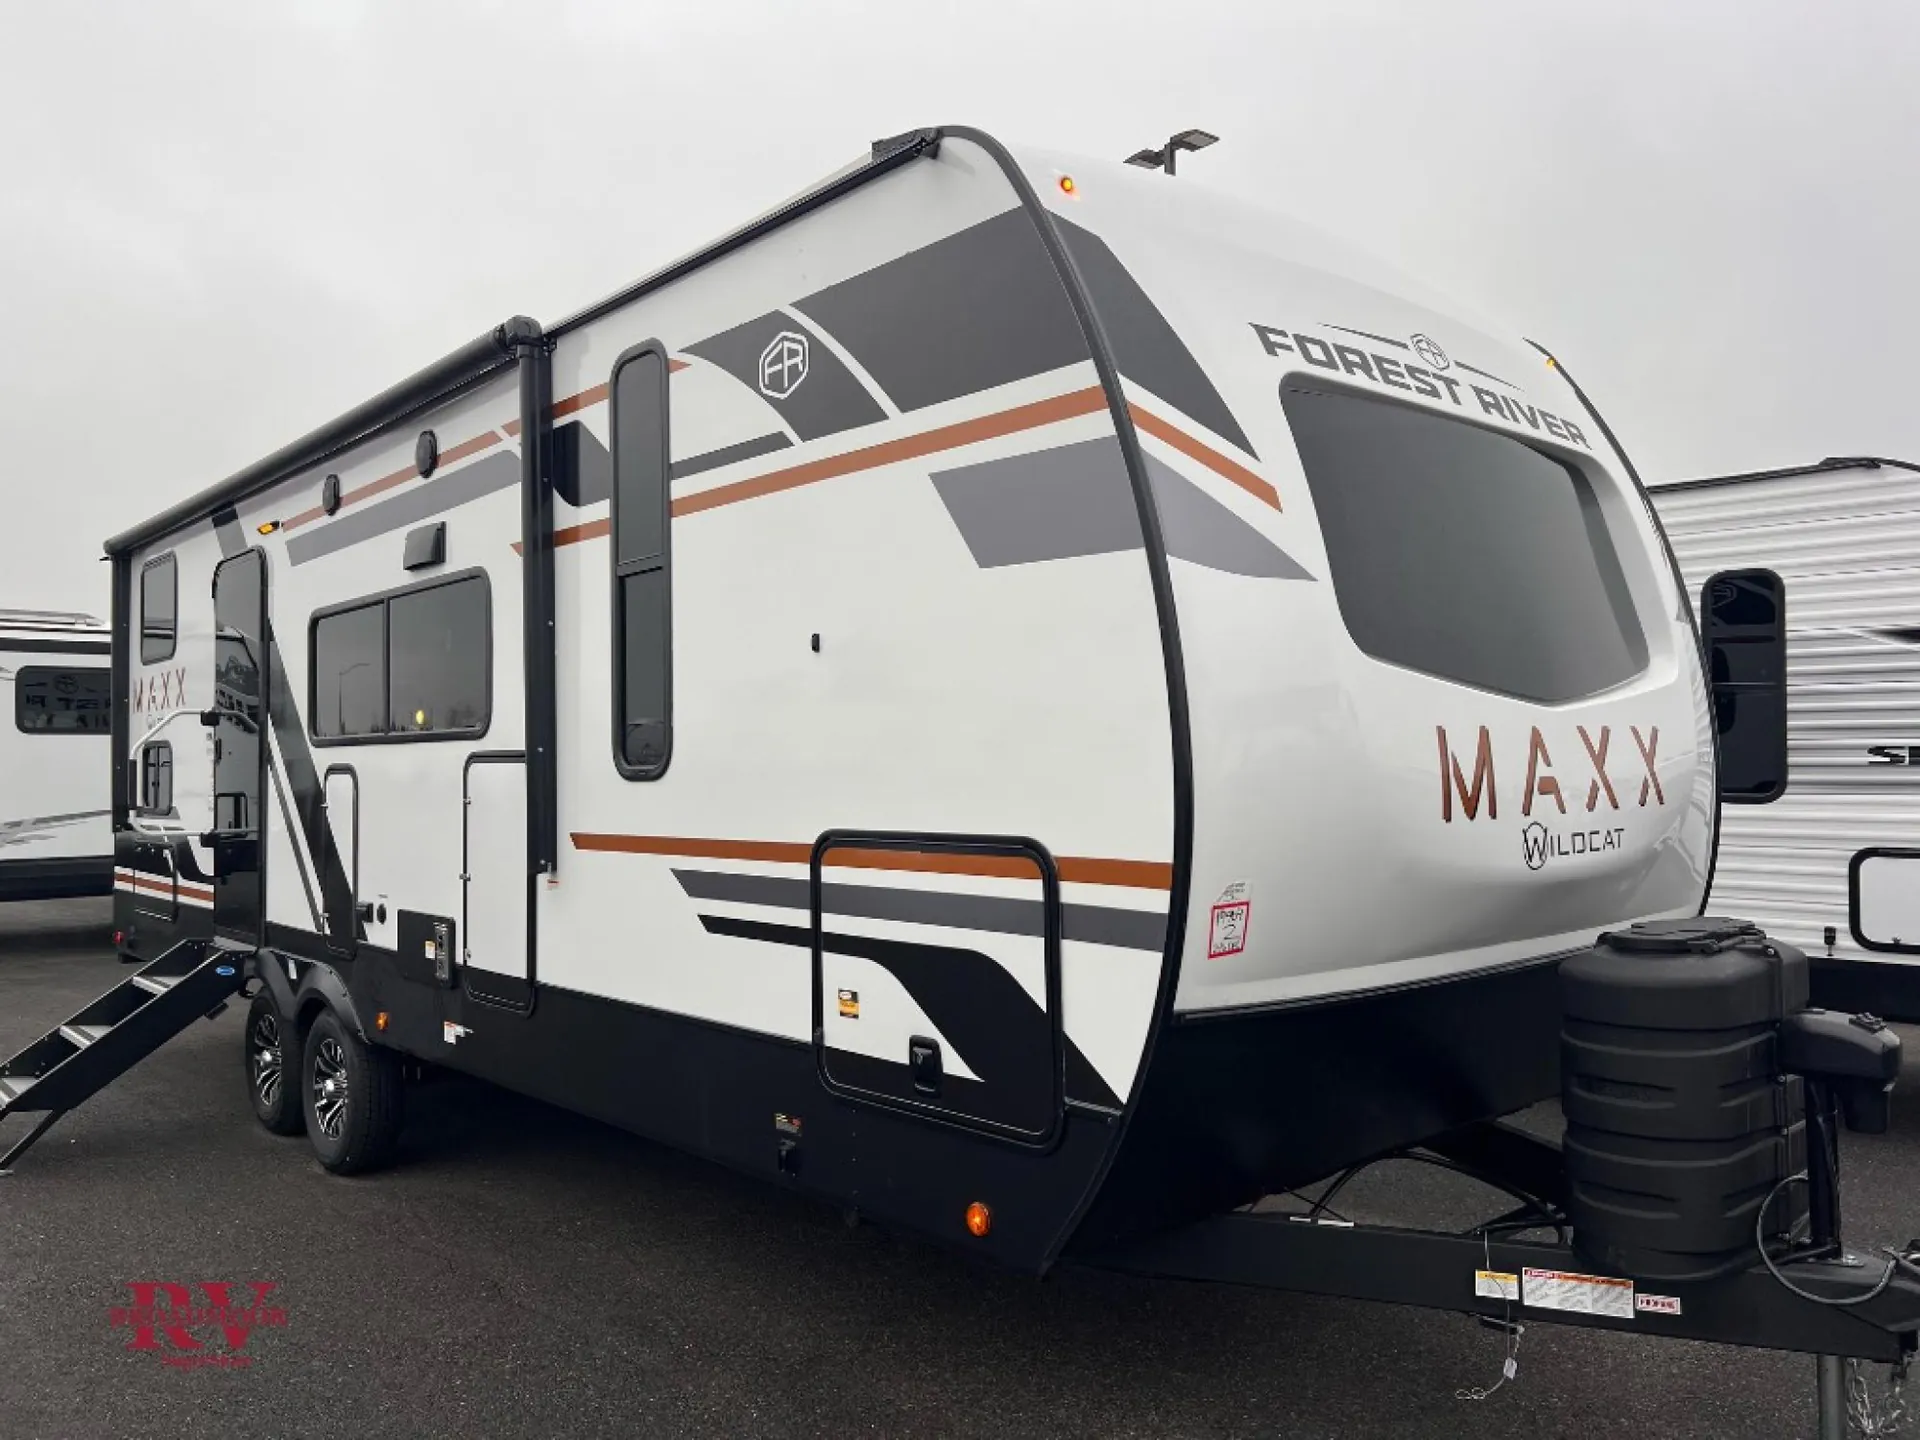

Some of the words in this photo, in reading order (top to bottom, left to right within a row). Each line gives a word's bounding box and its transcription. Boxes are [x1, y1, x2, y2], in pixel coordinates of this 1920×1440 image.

[1248, 322, 1461, 405] FOREST
[1469, 384, 1592, 450] RIVER
[133, 667, 185, 713] MAXX
[1436, 725, 1664, 823] MAXX
[1522, 821, 1625, 870] WILDCAT
